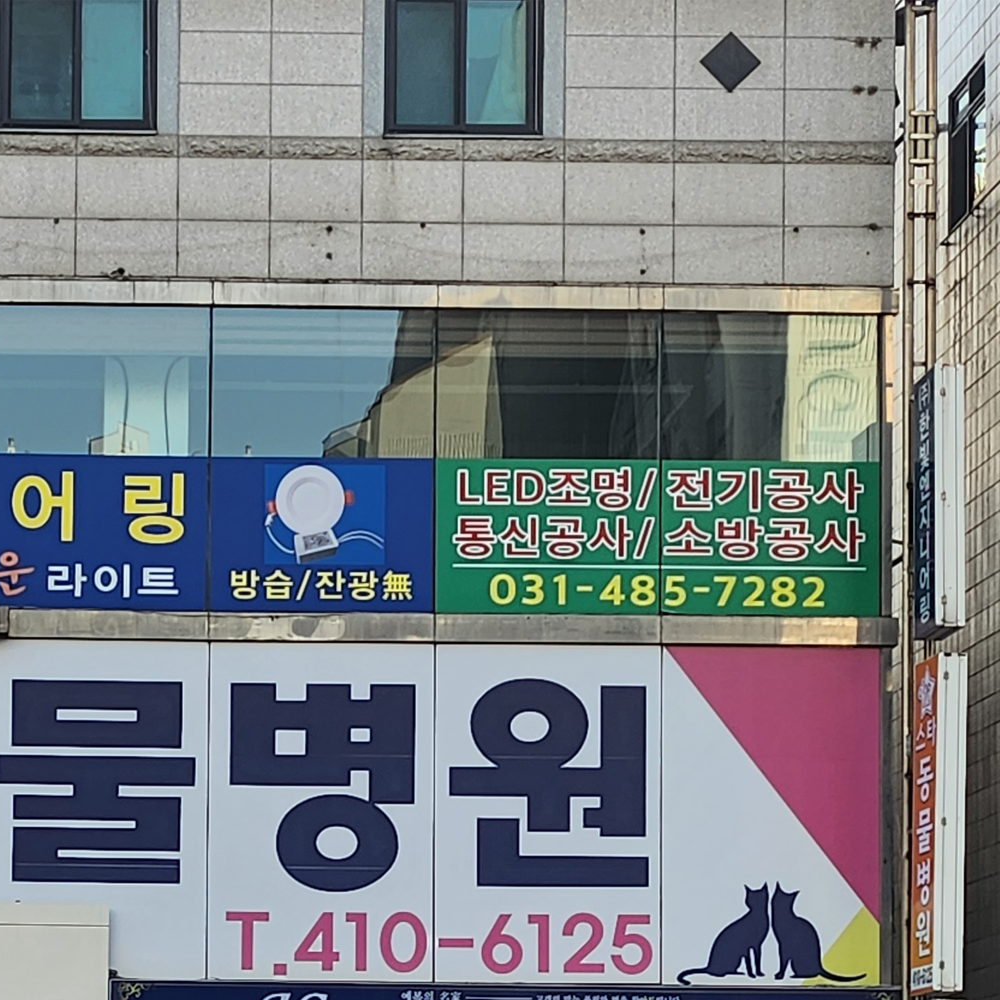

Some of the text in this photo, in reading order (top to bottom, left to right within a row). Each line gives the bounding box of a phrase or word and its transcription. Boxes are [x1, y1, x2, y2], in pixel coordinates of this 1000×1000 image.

[230, 568, 412, 602] 방습/잔광無
[488, 572, 827, 608] 031-485-7282
[915, 716, 936, 958] 스타동물병원
[227, 912, 652, 975] T.410-6125
